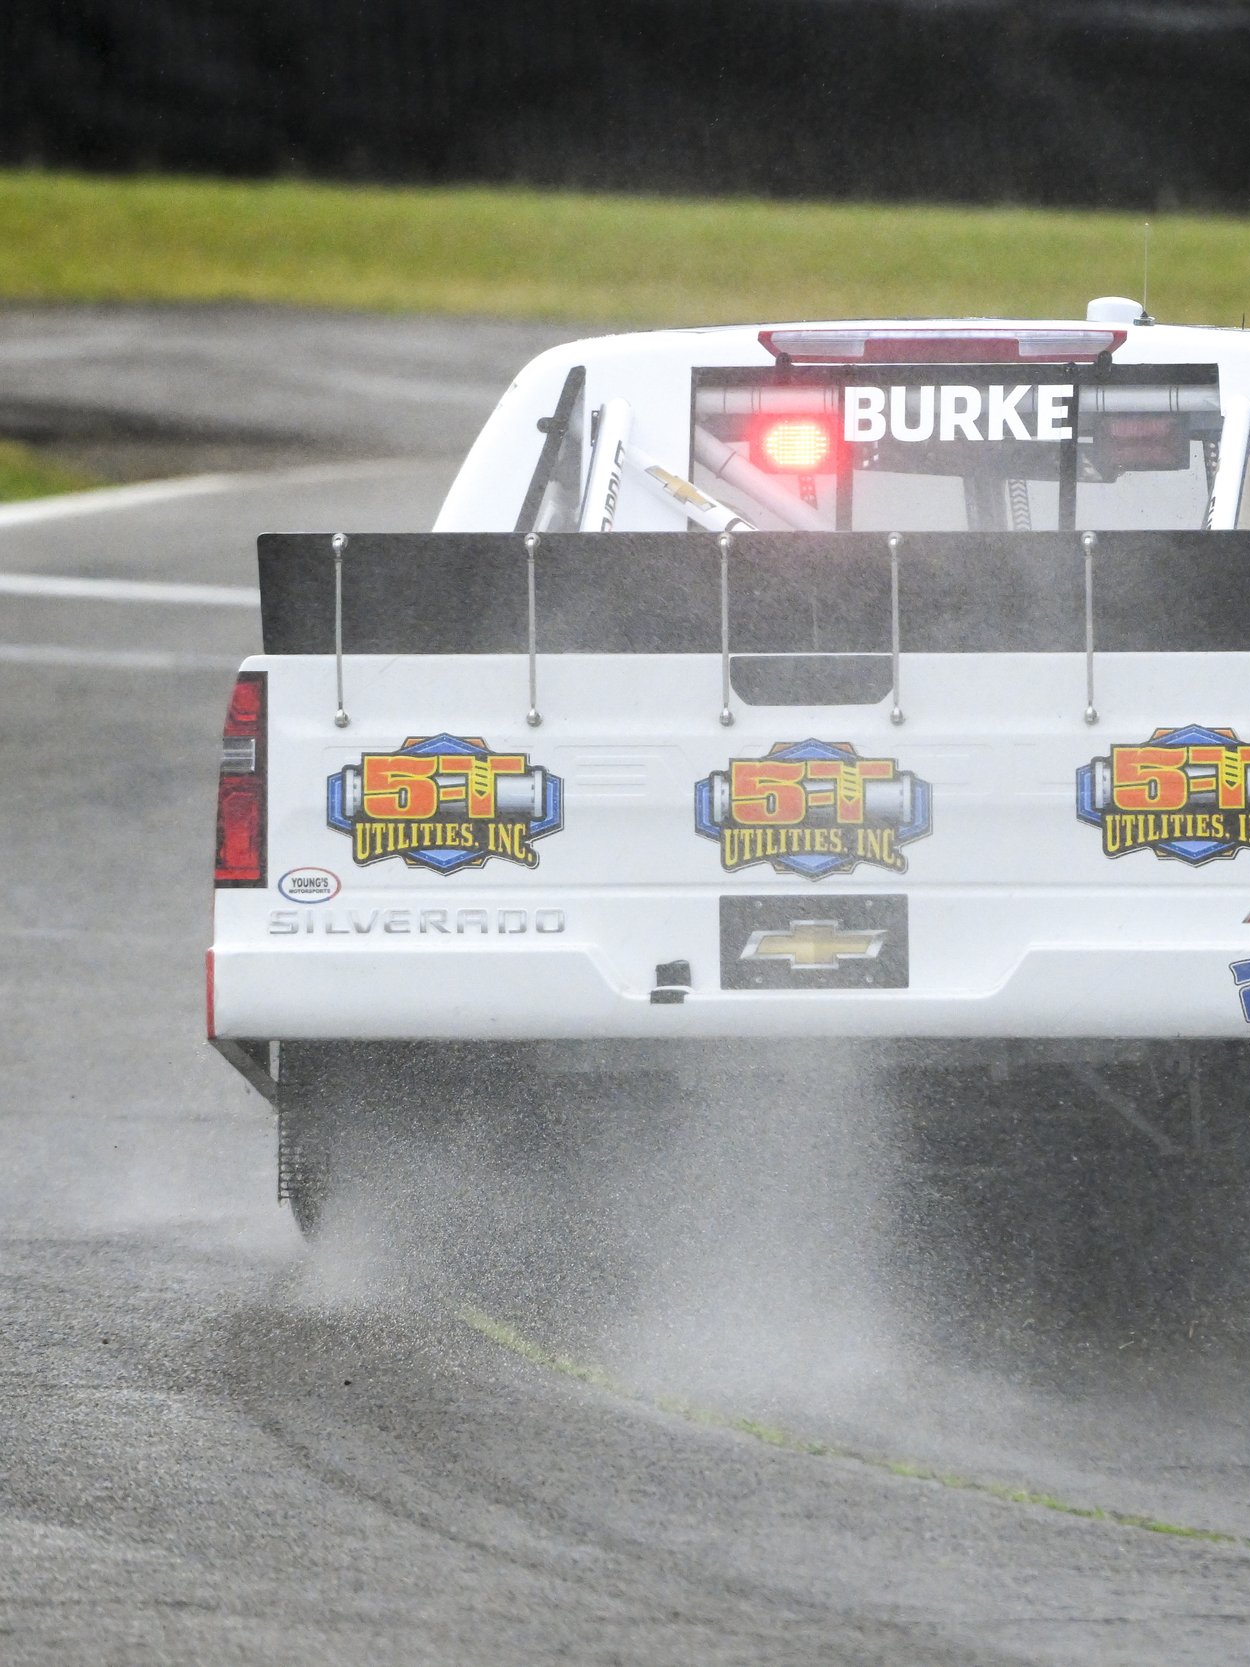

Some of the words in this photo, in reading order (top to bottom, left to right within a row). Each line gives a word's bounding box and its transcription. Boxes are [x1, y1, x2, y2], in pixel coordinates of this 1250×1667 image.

[843, 384, 1075, 442] BURKE
[488, 823, 534, 862] INC.
[857, 828, 902, 867] INC.
[291, 877, 329, 888] YOUNG'S
[269, 908, 566, 934] SILVERADO
